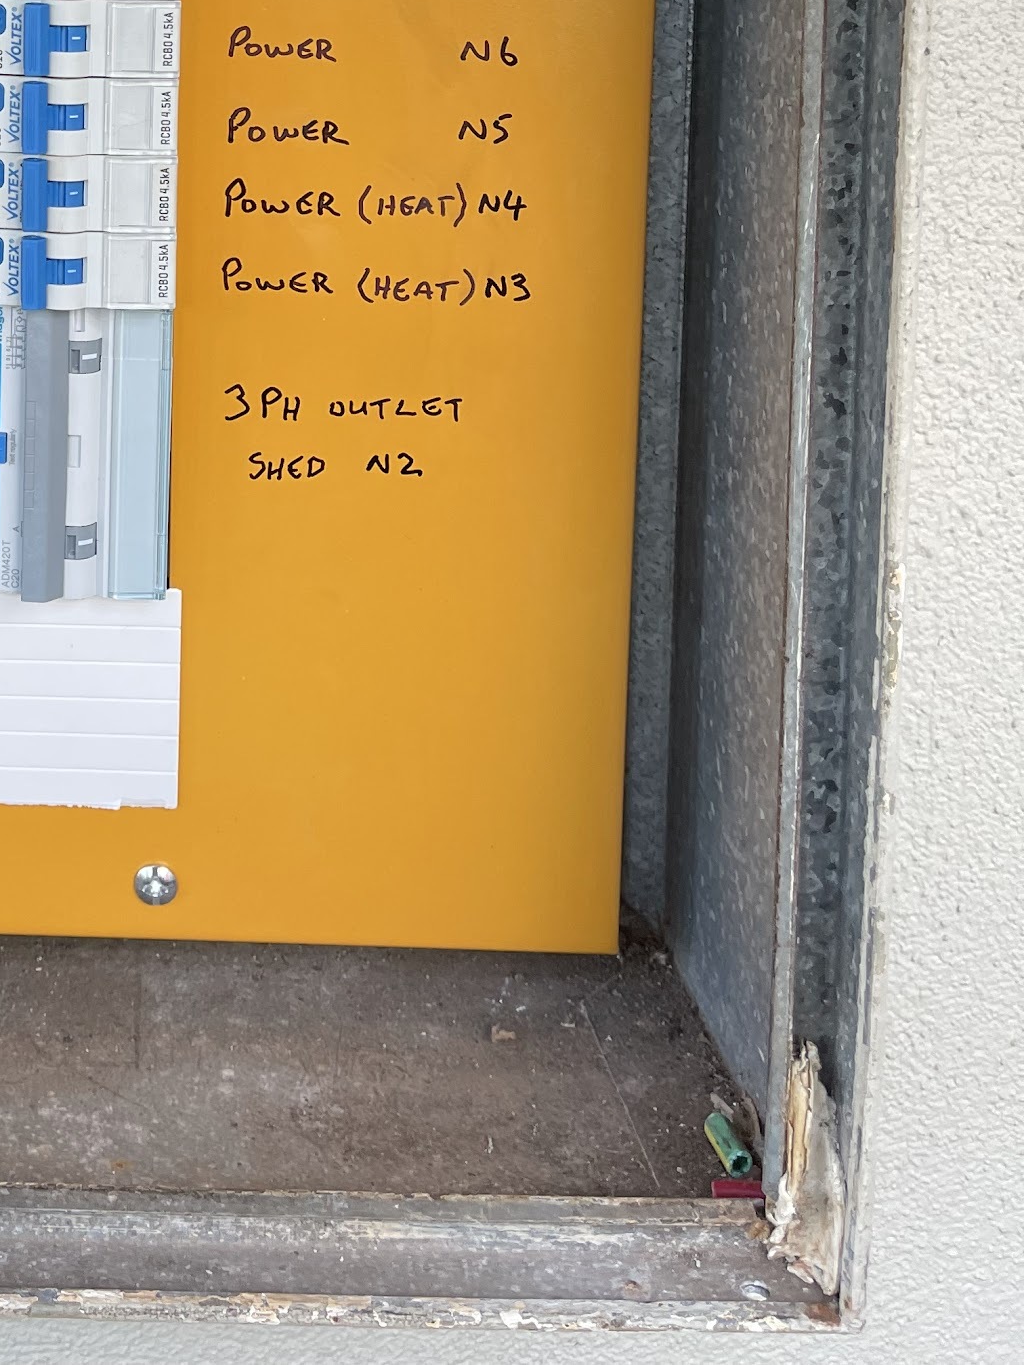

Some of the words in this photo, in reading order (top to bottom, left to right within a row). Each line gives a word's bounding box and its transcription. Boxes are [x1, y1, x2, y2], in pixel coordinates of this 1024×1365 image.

[162, 11, 174, 39] 4.5kA
[162, 38, 174, 67] RCBO
[228, 26, 337, 63] POWER
[460, 36, 518, 67] N6
[161, 91, 171, 117] 4.5kA
[161, 118, 171, 145] RCBO
[228, 107, 350, 145] POWER
[458, 113, 513, 144] N5
[159, 167, 170, 194] 4.5kA
[159, 194, 170, 222] RCBO
[224, 178, 341, 217] POWER
[358, 182, 467, 227] (HEAT)
[478, 190, 527, 221] N4
[158, 244, 169, 272] 4.5kA
[158, 272, 169, 298] RCBO
[221, 257, 334, 294] POWER
[357, 267, 476, 306] (HEAT)
[484, 273, 532, 302] N3
[329, 397, 463, 422] OUTLET
[248, 452, 326, 481] SHED
[366, 453, 423, 478] N2
[2, 539, 11, 589] ADM420T
[11, 568, 20, 589] C20
